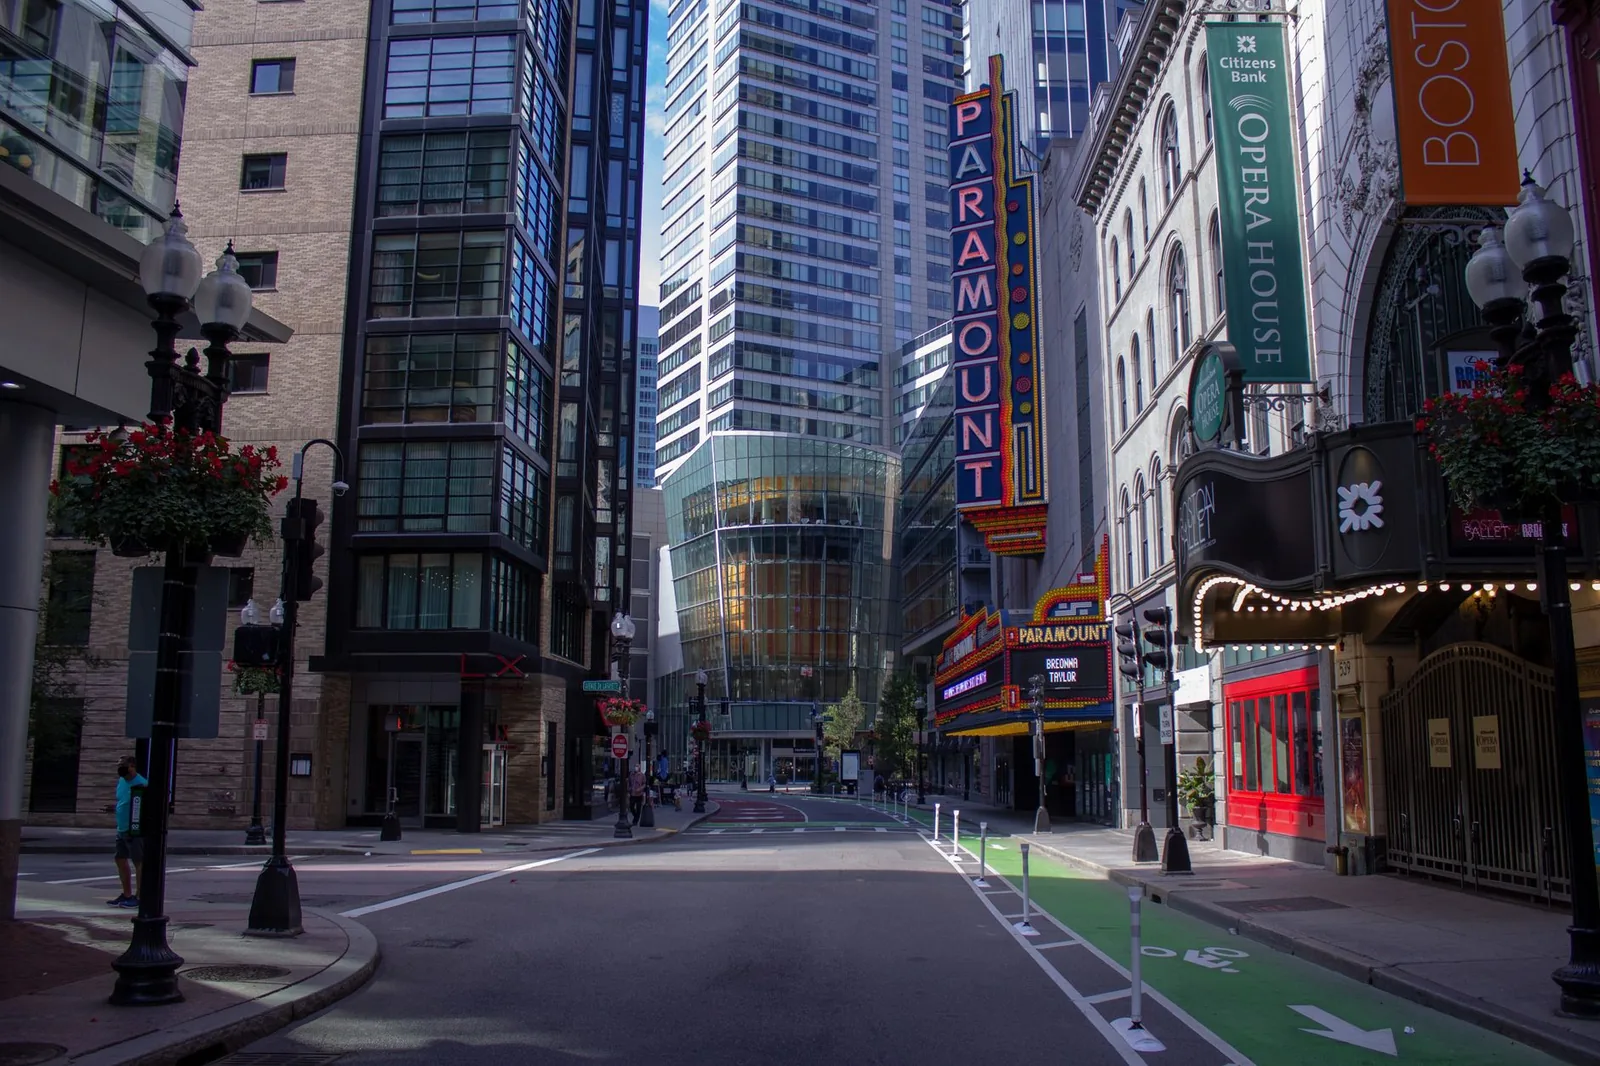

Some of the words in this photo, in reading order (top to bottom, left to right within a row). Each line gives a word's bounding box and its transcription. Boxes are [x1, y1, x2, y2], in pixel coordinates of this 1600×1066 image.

[1220, 57, 1276, 69] Citizens
[1231, 70, 1267, 82] Bank
[1411, 0, 1480, 165] BOST
[1238, 112, 1272, 232] OPERA
[956, 101, 993, 498] PARAMOUNT
[1248, 240, 1282, 364] HOUSE
[1198, 380, 1220, 414] OPERA
[1202, 401, 1220, 430] HOUSE
[1464, 526, 1509, 541] BALLET
[1019, 625, 1109, 643] PARAMOUNT
[1046, 657, 1078, 669] BREONNA
[1339, 660, 1351, 676] 539
[1049, 671, 1077, 683] TAYLOR
